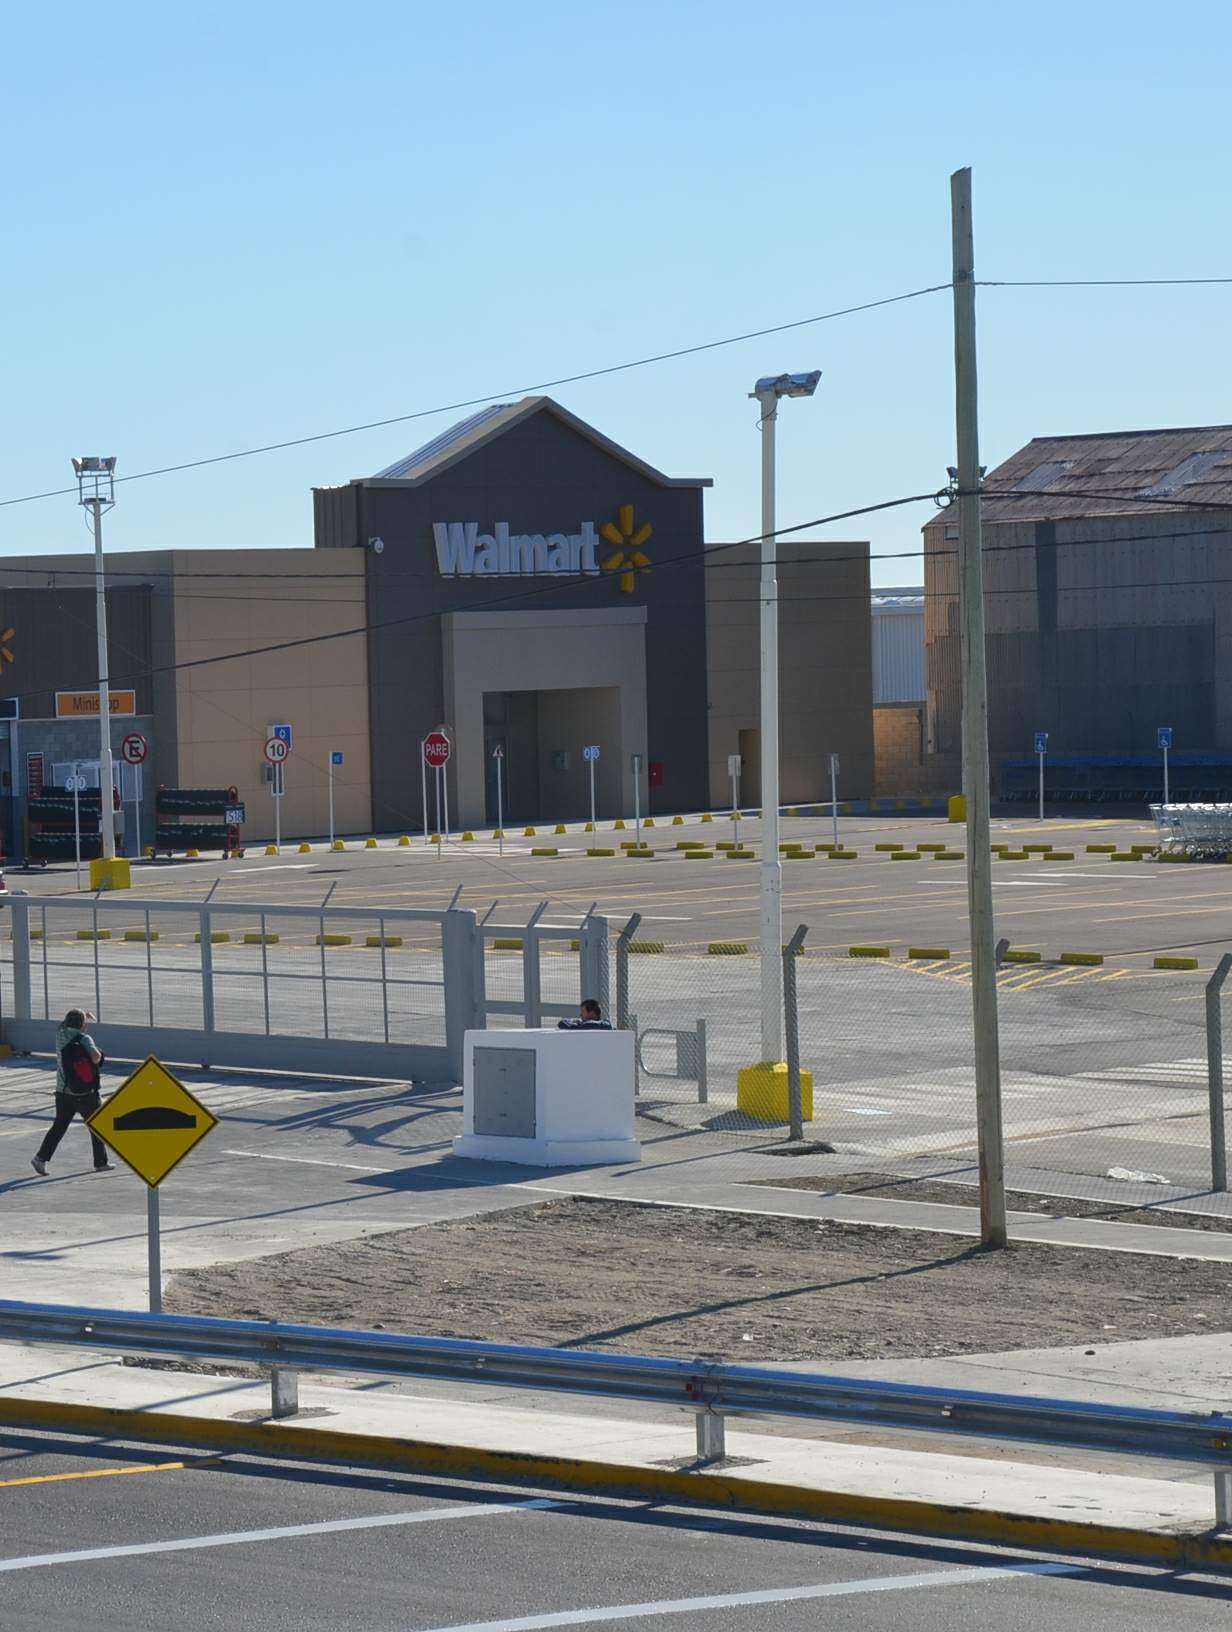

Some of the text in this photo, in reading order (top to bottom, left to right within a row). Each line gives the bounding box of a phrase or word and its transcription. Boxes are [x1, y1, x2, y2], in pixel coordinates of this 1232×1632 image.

[432, 521, 600, 578] Walmart
[129, 740, 141, 757] E
[270, 744, 285, 757] 10
[426, 743, 448, 756] PARE
